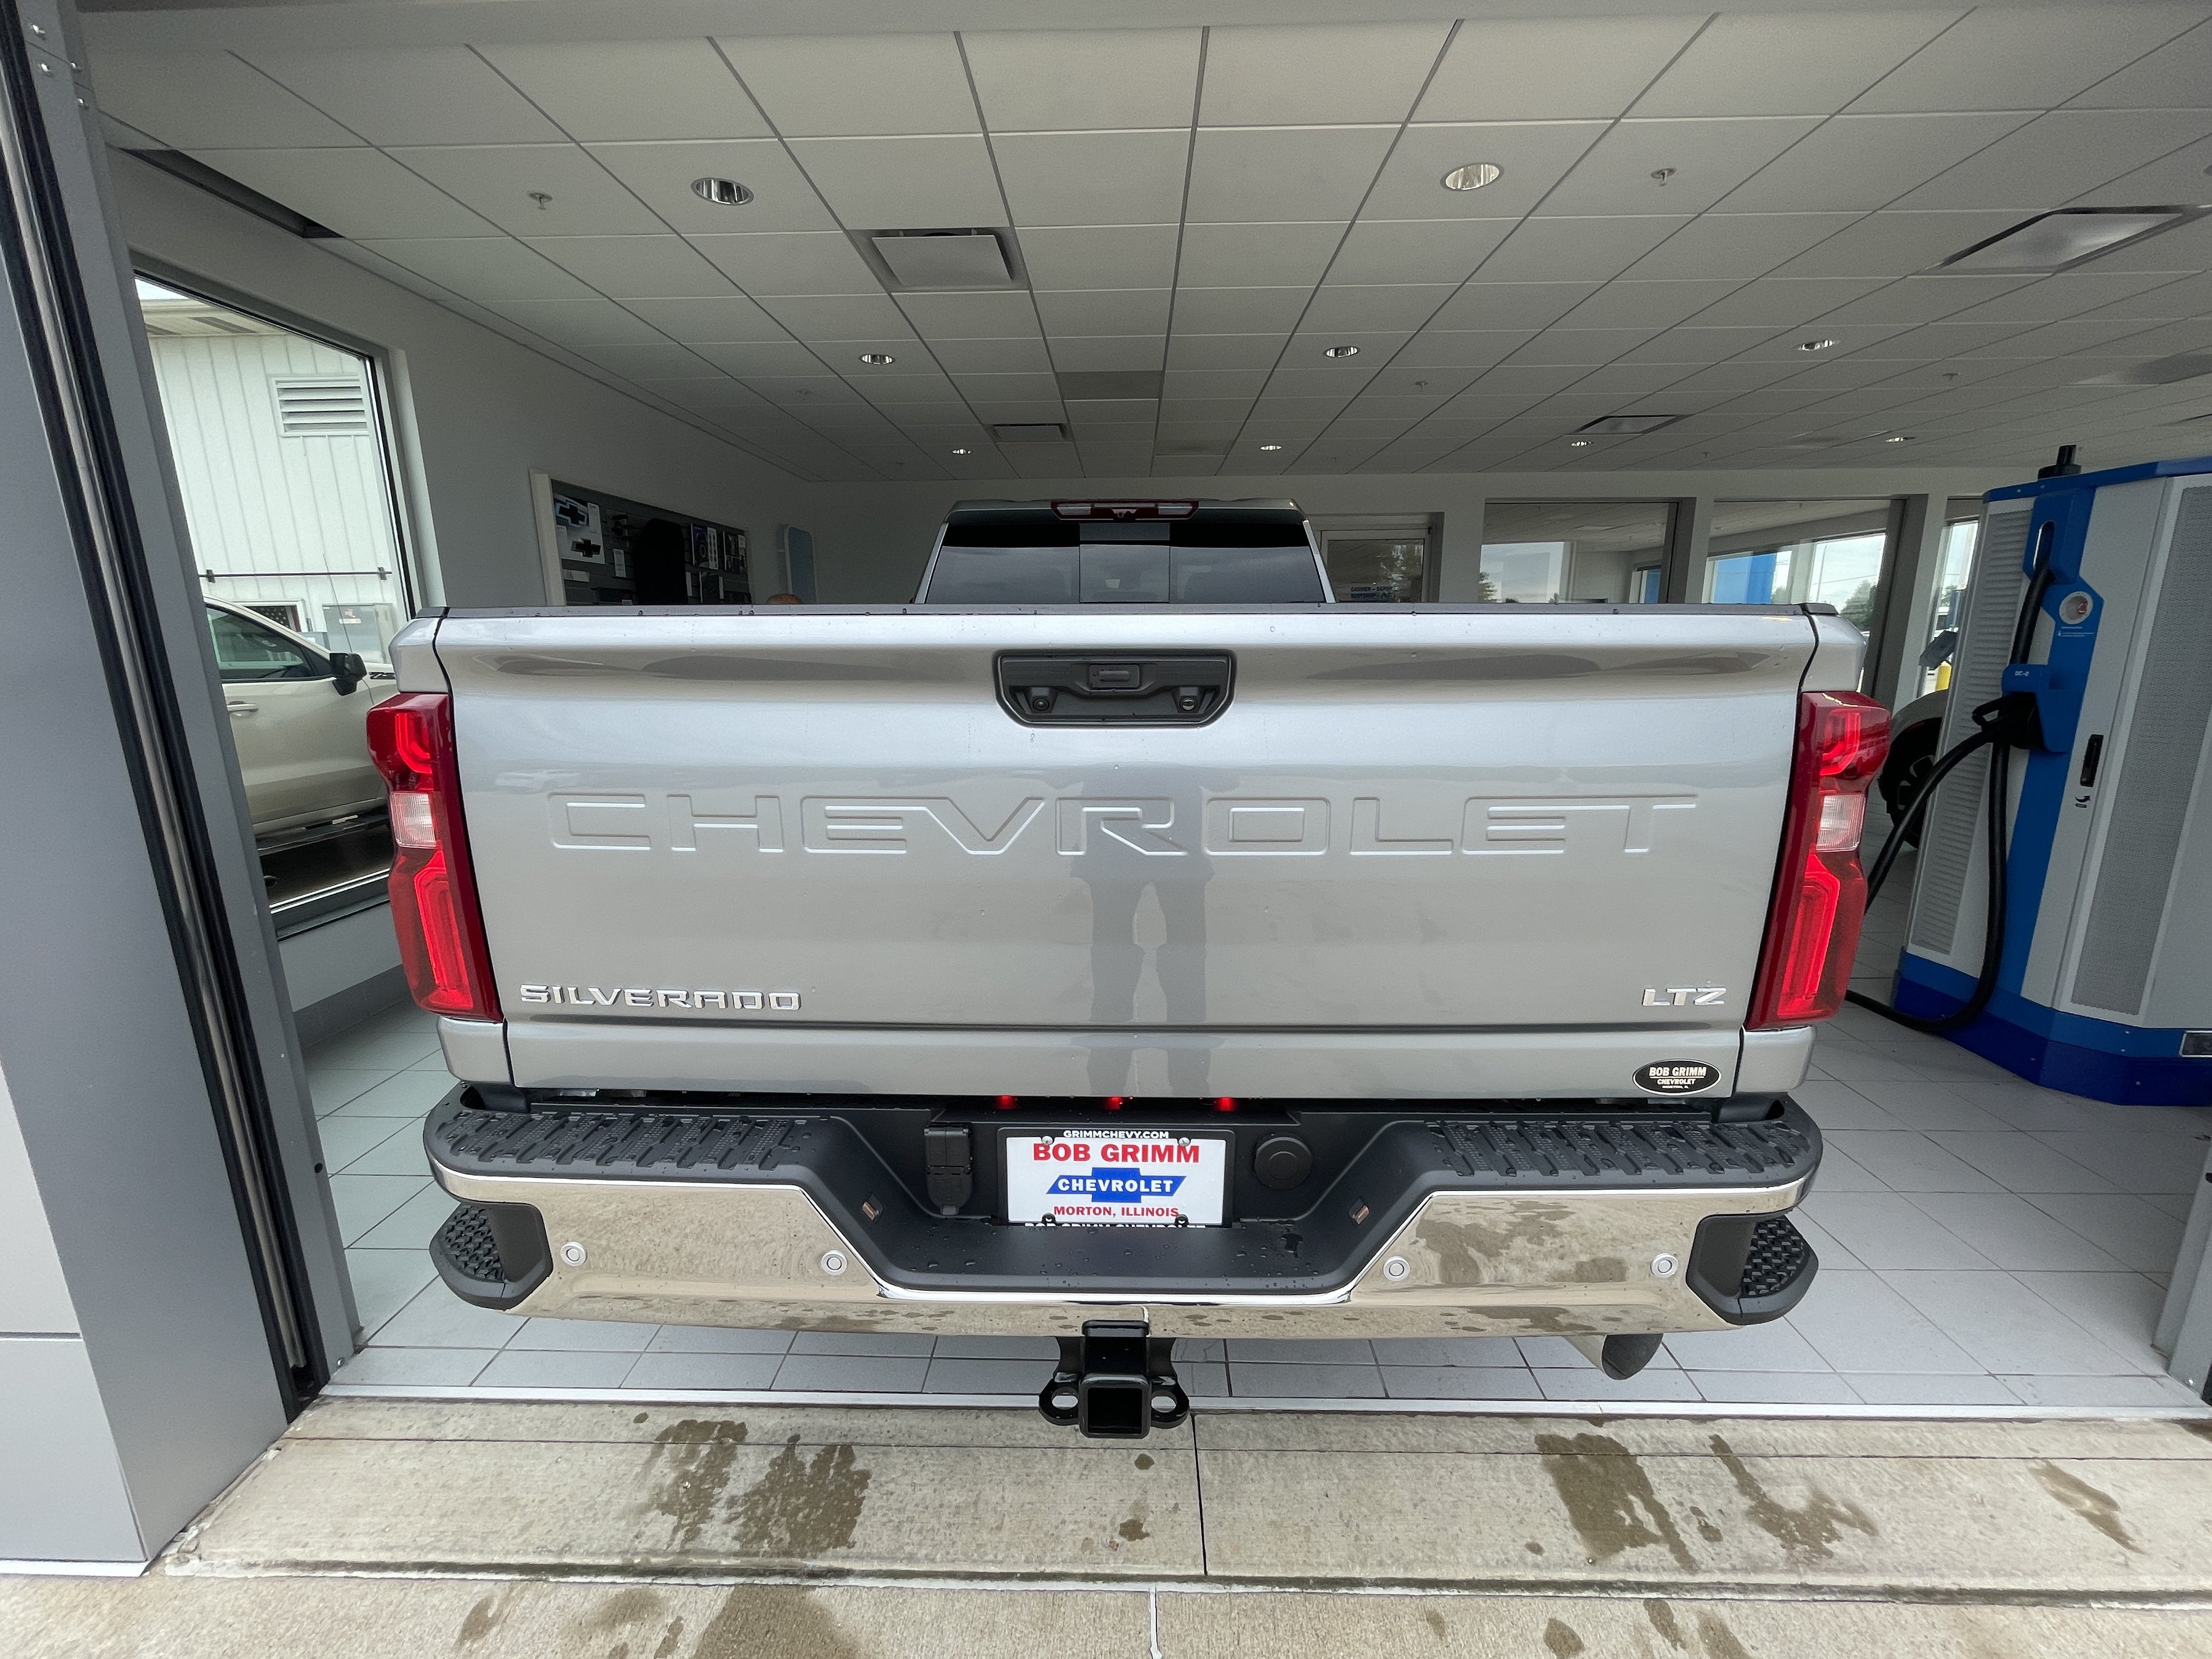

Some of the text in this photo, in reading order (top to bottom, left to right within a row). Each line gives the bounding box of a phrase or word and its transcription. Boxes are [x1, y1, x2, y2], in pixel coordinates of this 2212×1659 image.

[549, 793, 1697, 856] CHEVROLET
[520, 984, 801, 1011] SILVERADO
[1642, 986, 1726, 1006] LTZ
[1649, 1066, 1707, 1076] BOB GRIMM
[1063, 1130, 1169, 1139] GRIMMCHEVY.COM
[1034, 1143, 1199, 1163] BOB GRIMM
[1058, 1178, 1173, 1192] CHEVROLET
[1053, 1206, 1179, 1217] MORTON, ILLINOIS
